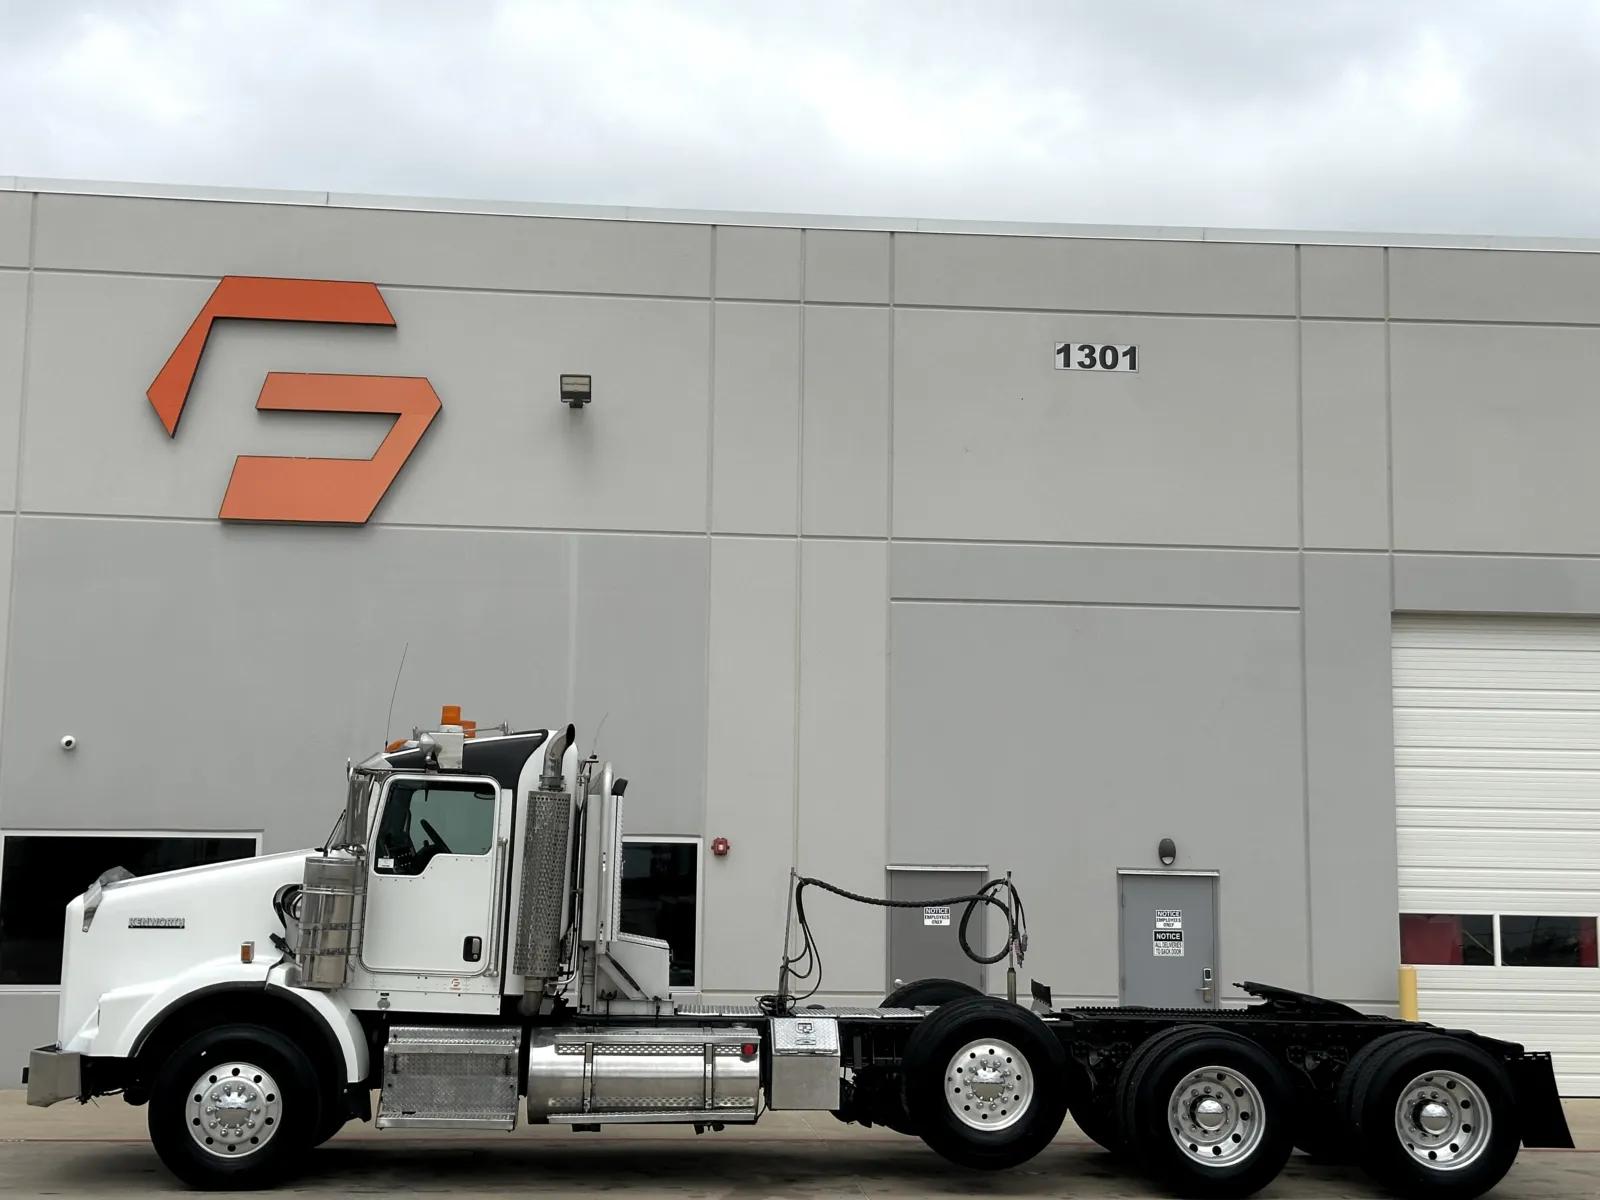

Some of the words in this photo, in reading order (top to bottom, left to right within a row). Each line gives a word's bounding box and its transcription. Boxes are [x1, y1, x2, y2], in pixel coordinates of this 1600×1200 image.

[1056, 343, 1137, 371] 1301
[128, 917, 185, 929] KENWORTH
[1156, 932, 1181, 940] NOTICE
